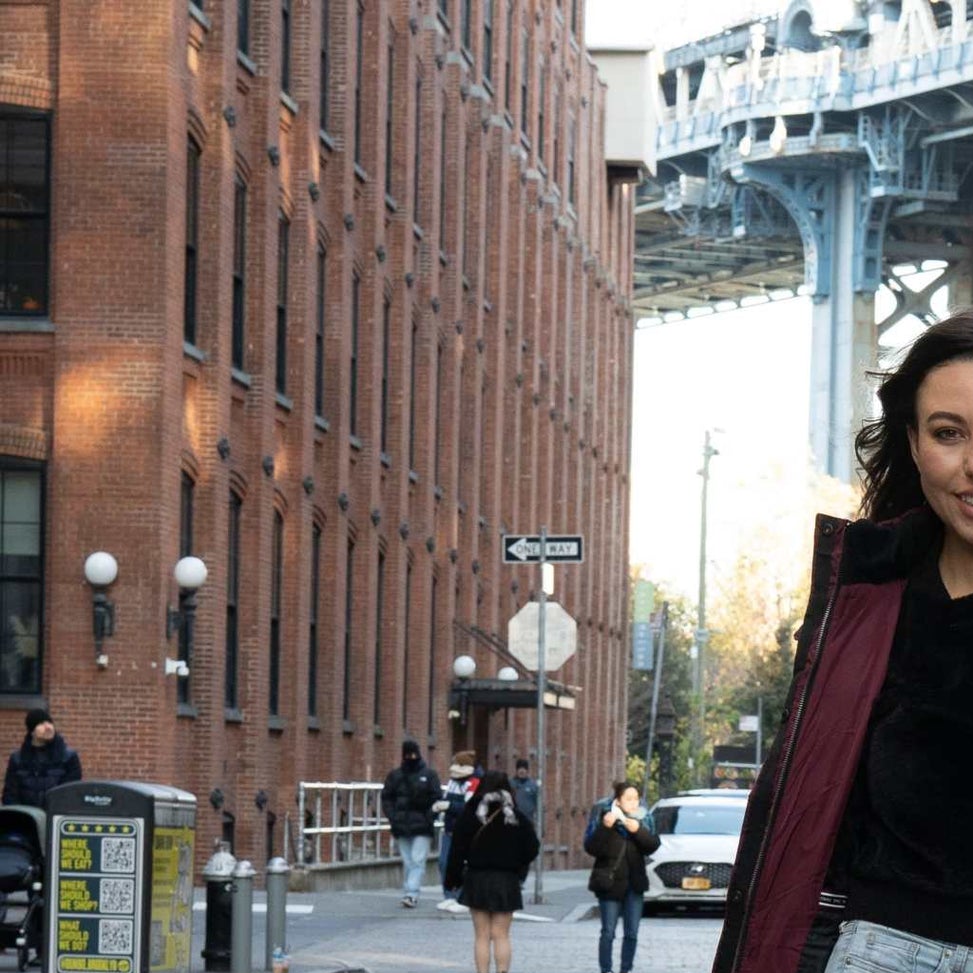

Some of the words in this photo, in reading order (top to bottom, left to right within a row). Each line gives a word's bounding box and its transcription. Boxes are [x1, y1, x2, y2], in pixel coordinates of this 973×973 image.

[516, 543, 537, 554] ONE
[549, 543, 573, 554] WAY
[61, 839, 87, 849] WHERE
[61, 849, 92, 859] SHOULD
[61, 859, 72, 869] WE
[74, 859, 92, 869] EAT?
[60, 880, 87, 890] WHERE
[60, 890, 90, 900] SHOULD
[60, 900, 71, 910] WE
[73, 900, 98, 911] SHOP?
[60, 920, 80, 930] WHAT
[60, 930, 89, 941] SHOULD
[59, 940, 70, 950] WE
